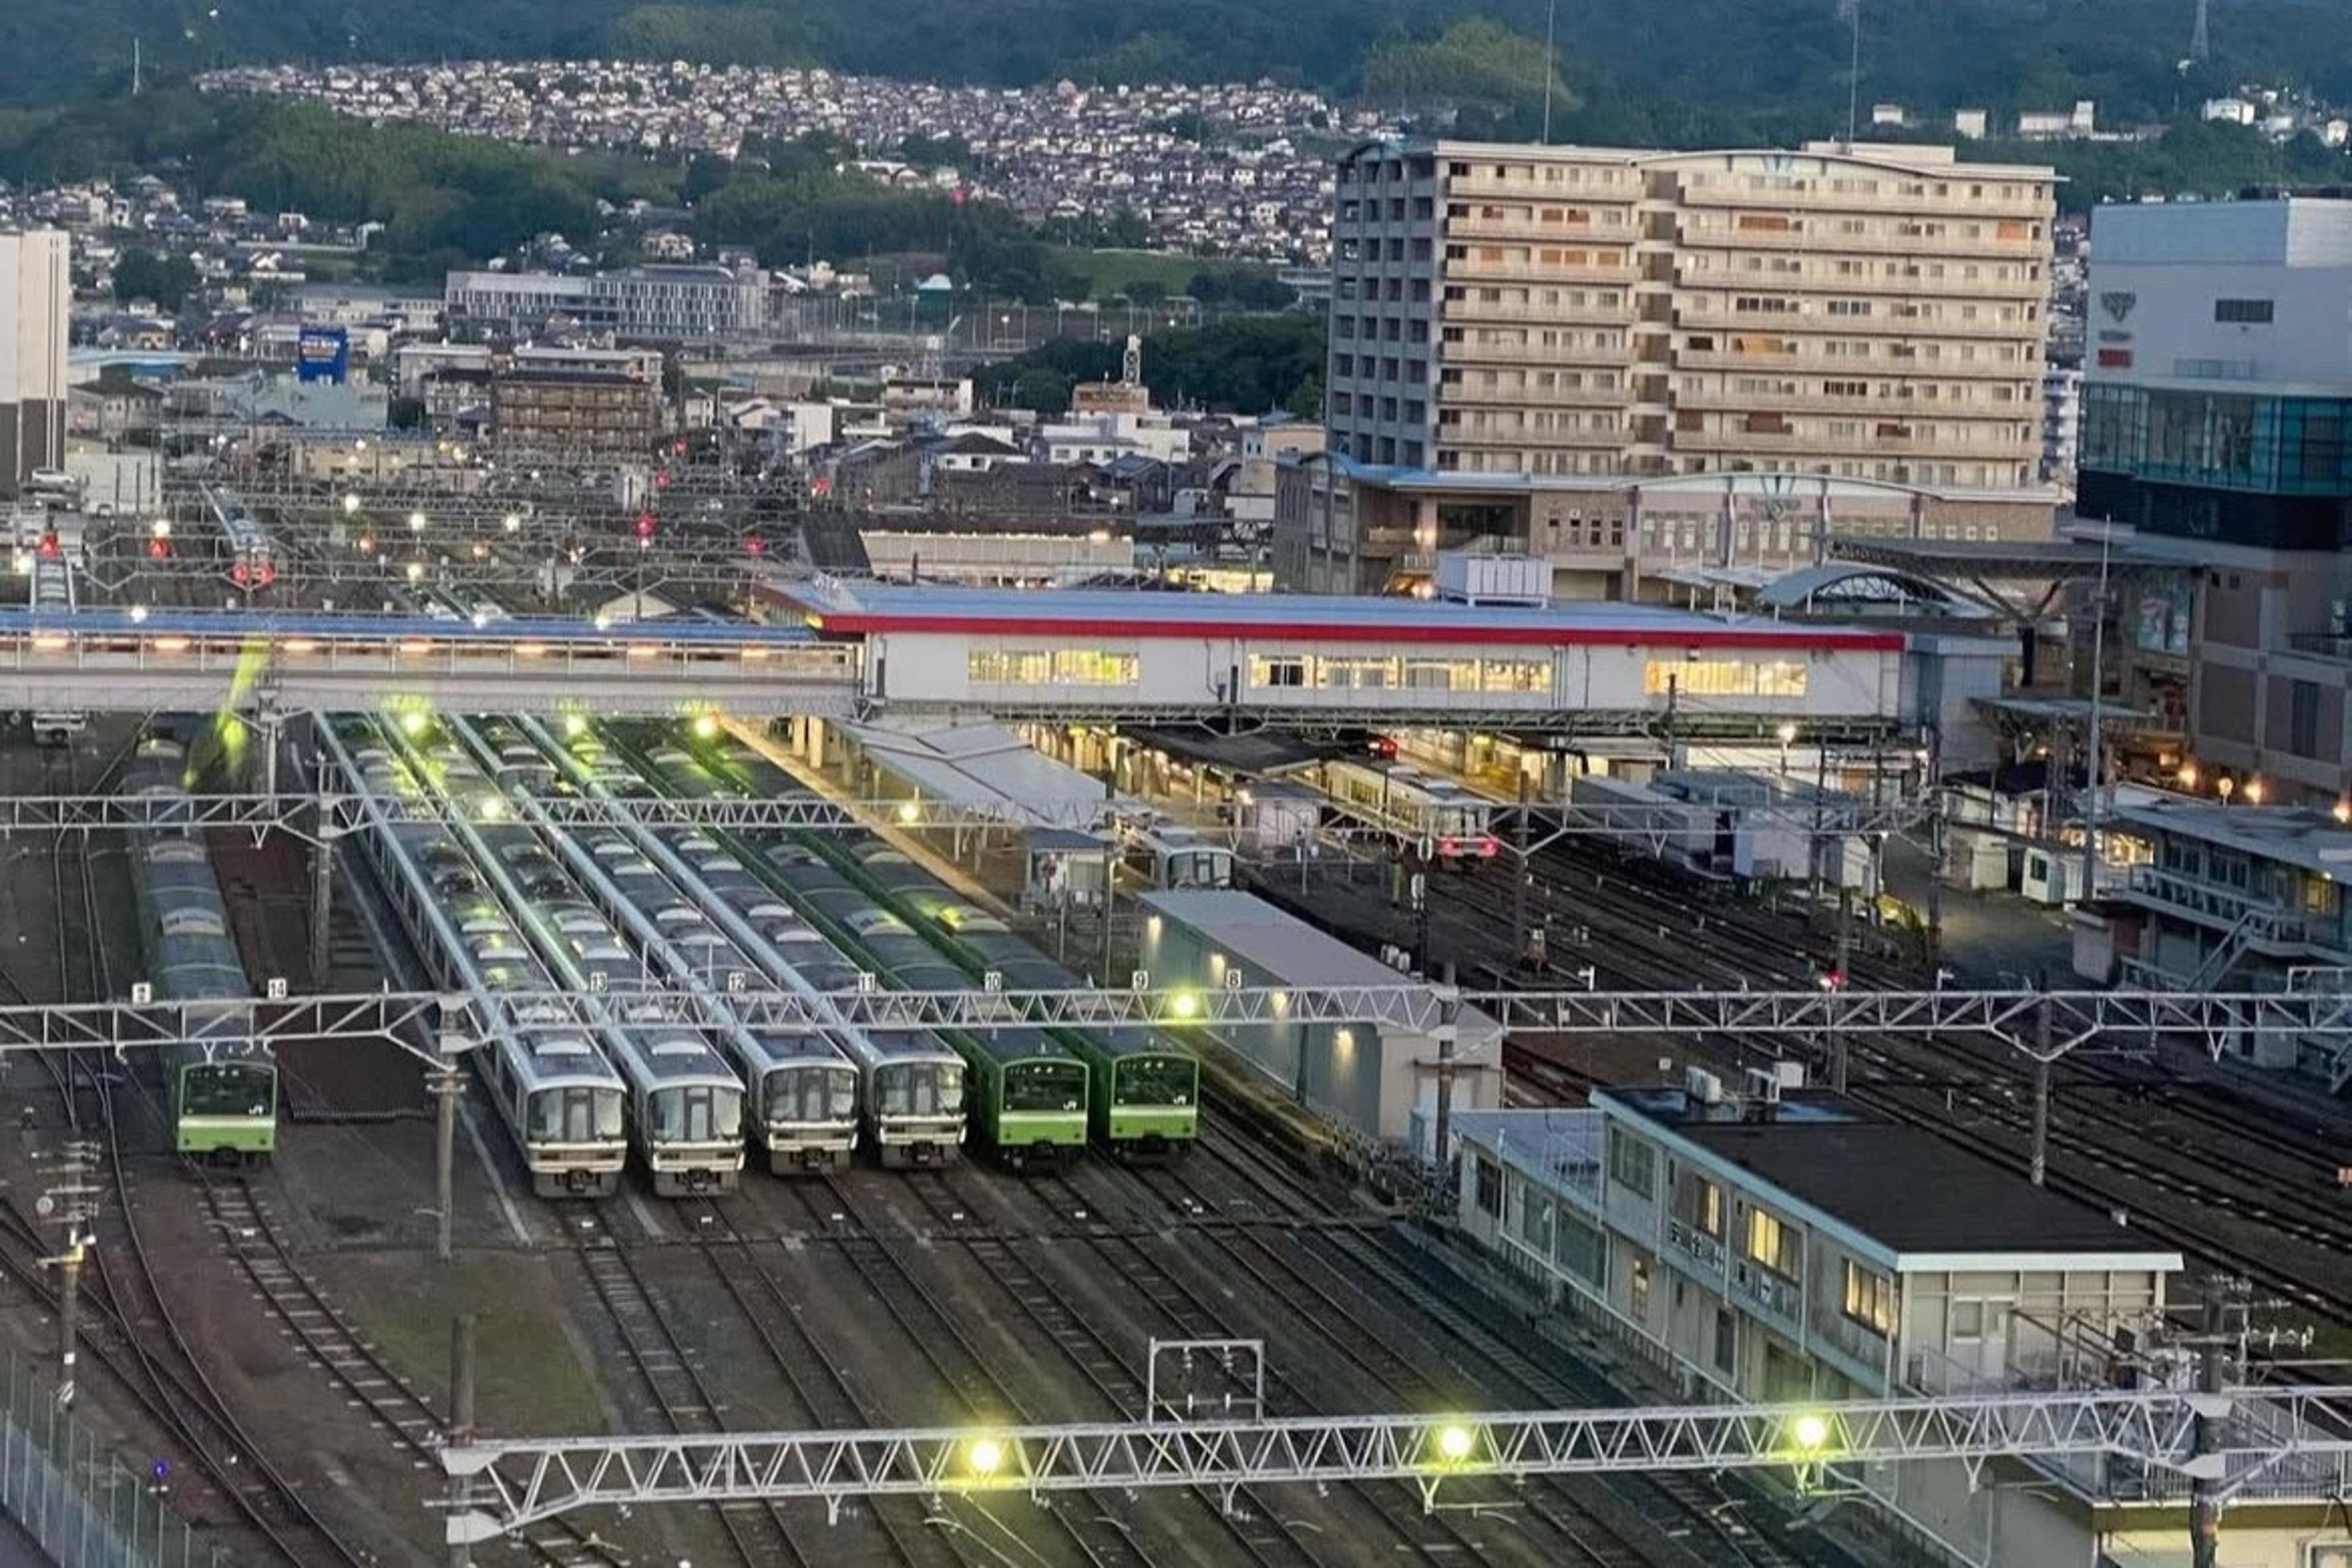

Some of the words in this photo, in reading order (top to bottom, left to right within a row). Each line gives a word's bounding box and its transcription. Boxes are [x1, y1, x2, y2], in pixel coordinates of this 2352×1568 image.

[731, 975, 744, 990] 12
[987, 974, 1000, 990] 10
[1136, 974, 1145, 989] 9
[1230, 973, 1238, 986] 8
[271, 982, 284, 997] 14
[1063, 1101, 1077, 1110] JR
[1173, 1095, 1186, 1105] JR
[249, 1105, 264, 1115] JR
